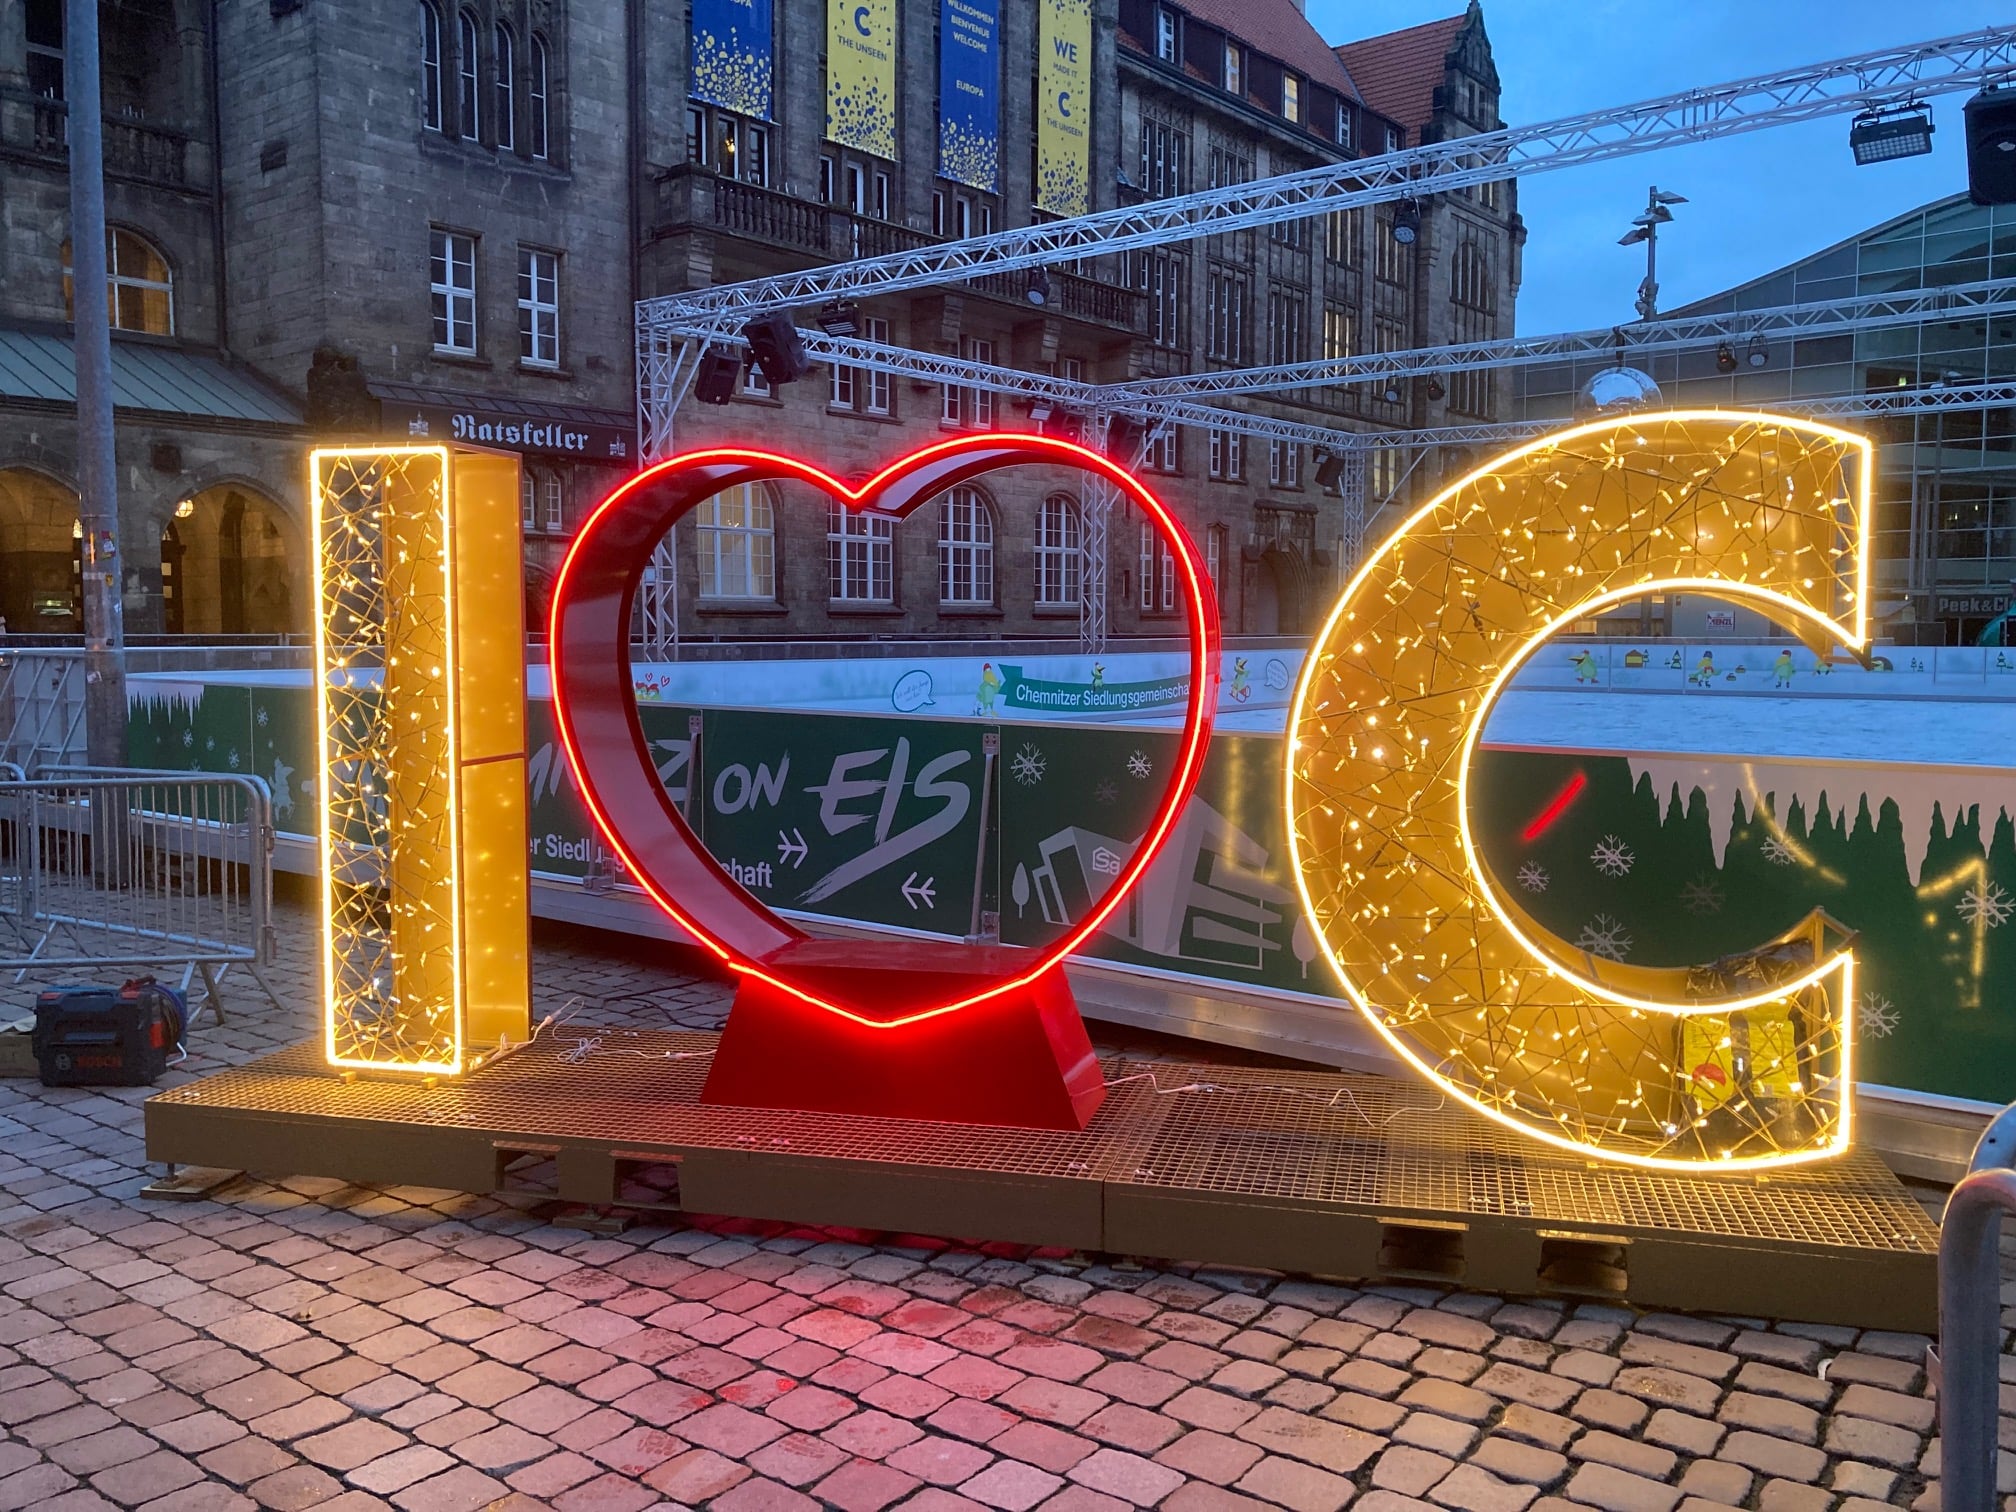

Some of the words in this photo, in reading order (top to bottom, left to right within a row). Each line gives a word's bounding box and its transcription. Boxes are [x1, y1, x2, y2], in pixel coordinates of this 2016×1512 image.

[854, 6, 871, 37] C
[951, 14, 990, 39] BIENVENUE
[837, 34, 854, 49] THE
[856, 42, 887, 61] UNSEEN
[953, 31, 987, 53] WELCOME
[1053, 36, 1077, 63] WE
[1053, 62, 1071, 77] MADE
[956, 79, 984, 98] EUROPA
[1058, 92, 1071, 117] C
[1047, 117, 1058, 129] THE
[1059, 122, 1083, 137] UNSEEN
[451, 414, 589, 450] Ratskeller
[1938, 597, 2009, 613] Peek&Cl
[1016, 684, 1082, 706] Chemnitzer
[1083, 683, 1190, 708] Siedlungsgemeinscha
[1285, 409, 1875, 1178] C
[713, 748, 790, 815] ON
[794, 737, 972, 905] EIS
